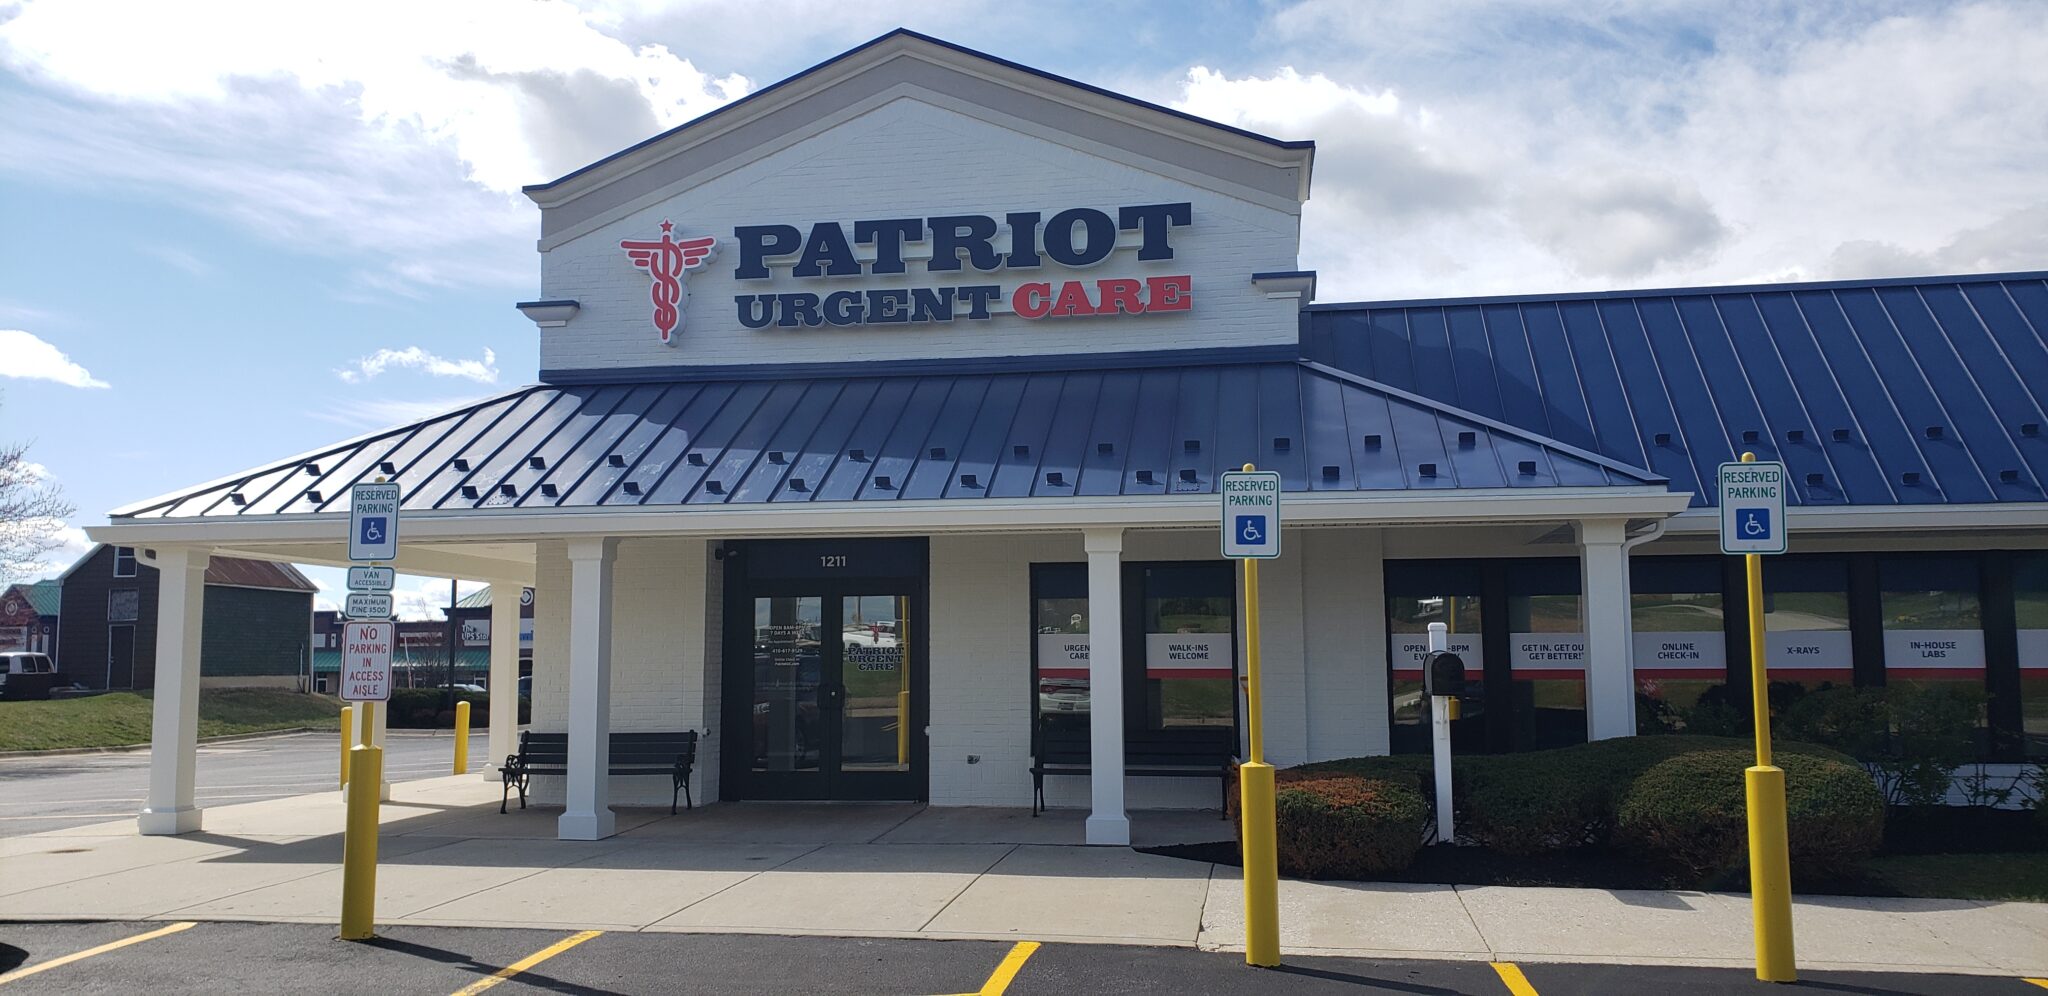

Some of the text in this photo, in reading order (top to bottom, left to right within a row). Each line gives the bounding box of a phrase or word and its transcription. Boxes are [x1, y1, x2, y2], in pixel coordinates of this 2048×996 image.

[734, 202, 1192, 281] PATRIOT
[734, 274, 1193, 329] URGENT CARE
[1724, 471, 1780, 483] RESERVED
[1225, 480, 1276, 491] RESERVED
[355, 490, 397, 501] RESERVED
[1728, 487, 1777, 498] PARKING
[1229, 495, 1273, 506] PARKING
[356, 503, 393, 514] PARKING
[820, 556, 847, 567] 1211
[363, 571, 380, 579] VAN
[359, 628, 378, 640] NO
[476, 632, 489, 640] Stor
[349, 643, 387, 654] PARKING
[1168, 644, 1209, 652] WALK-INS
[1403, 644, 1426, 652] OPEN
[1539, 643, 1552, 652] IN.
[1553, 643, 1570, 652] GET
[1571, 644, 1584, 652] OU
[1661, 642, 1695, 651] ONLINE
[1910, 641, 1957, 649] IN-HOUSE
[847, 647, 905, 655] PATRIOT
[1786, 646, 1820, 655] X-RAYS
[1922, 650, 1946, 658] LABS
[848, 655, 904, 663] URGENT
[1069, 652, 1090, 660] CARE
[1168, 652, 1209, 660] WELCOME
[1528, 652, 1545, 660] GET
[1657, 651, 1700, 660] CHECK-IN
[362, 657, 372, 668] IN
[858, 663, 895, 672] CARE
[349, 671, 384, 682] ACCESS
[352, 684, 379, 696] AISLE
